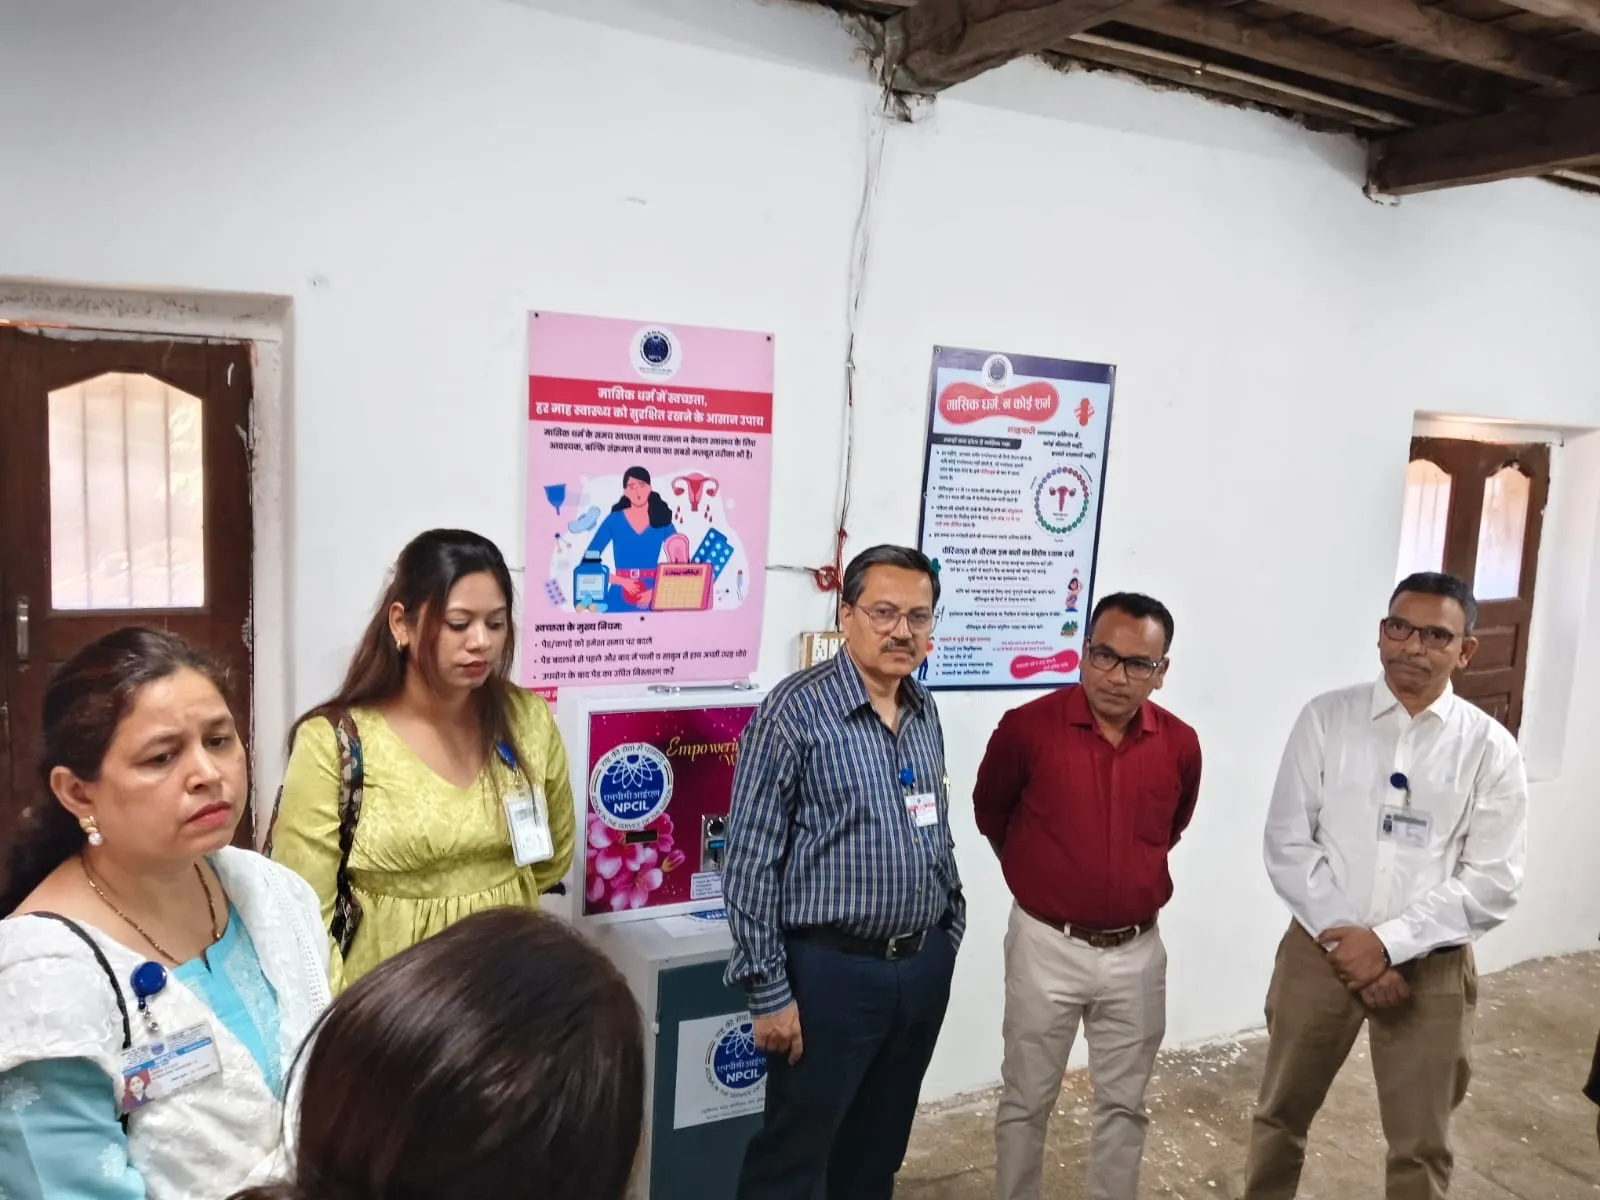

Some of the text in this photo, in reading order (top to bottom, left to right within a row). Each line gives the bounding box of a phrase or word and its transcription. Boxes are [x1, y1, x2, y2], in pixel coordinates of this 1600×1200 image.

[597, 385, 707, 407] मासिक धर्म में स्वच्छता,
[946, 395, 979, 411] मासिक
[1002, 398, 1011, 409] न
[1013, 395, 1032, 411] कोई
[1034, 395, 1051, 409] शर्म
[536, 402, 764, 427] हर माह स्वास्थ्य को सुरक्षित रखने के आसान उपाय
[544, 427, 569, 437] मासिक
[571, 428, 584, 438] धर्म
[585, 428, 593, 438] के
[594, 431, 613, 440] समय
[535, 623, 565, 632] स्वच्छता
[567, 621, 575, 632] के
[577, 622, 596, 634] मुख्य
[574, 638, 584, 648] को
[606, 639, 624, 647] समय
[542, 671, 566, 680] उपयोग
[567, 670, 576, 680] के
[666, 736, 739, 762] Empoweri
[613, 799, 650, 814] NPCIL
[726, 1068, 761, 1084] NPCIL
